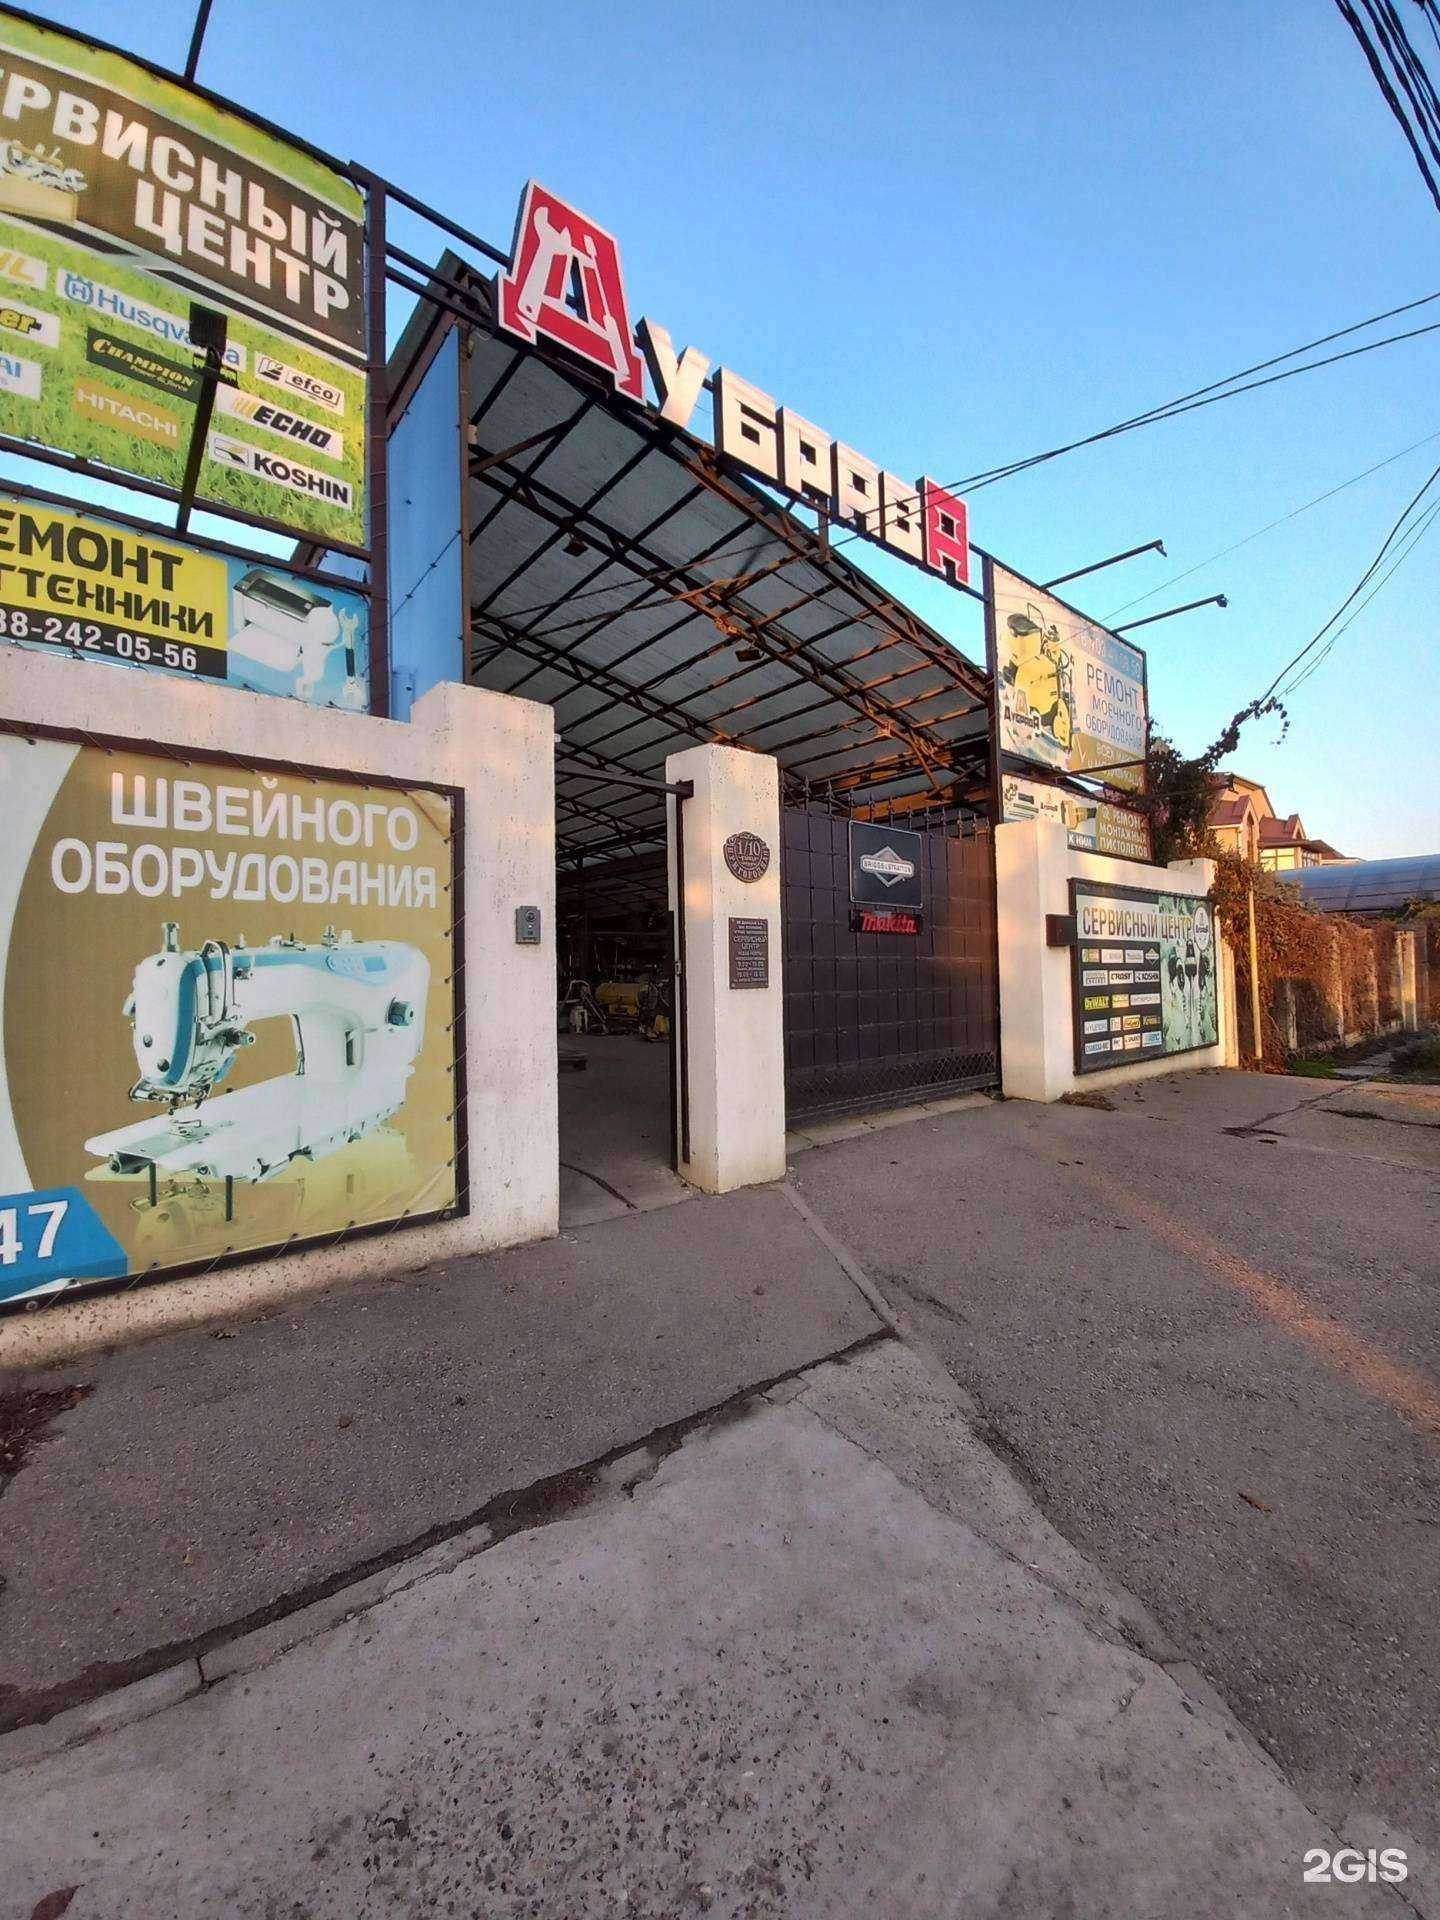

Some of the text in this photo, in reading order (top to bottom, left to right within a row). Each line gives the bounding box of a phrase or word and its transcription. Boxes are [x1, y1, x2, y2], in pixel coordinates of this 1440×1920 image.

[0, 69, 348, 279] РВИСНЫЙ
[134, 179, 349, 318] ЦЕНТР
[92, 339, 196, 387] CHAMPION
[292, 375, 333, 400] efco
[499, 179, 970, 585] ДУБРАВА
[77, 388, 177, 438] HITACHI
[252, 404, 331, 448] ECHO
[254, 452, 348, 503] KOSHIN
[1086, 662, 1138, 708] РЕМОНТ
[1092, 695, 1142, 731] МОЕЧНОГО
[111, 772, 418, 851] ШВЕЙНОГО
[51, 838, 437, 908] ОБОРУДОВАНИЯ
[1083, 905, 1158, 938] СЕРВИСНЫЙ
[1161, 915, 1192, 941] ЦЕНТР
